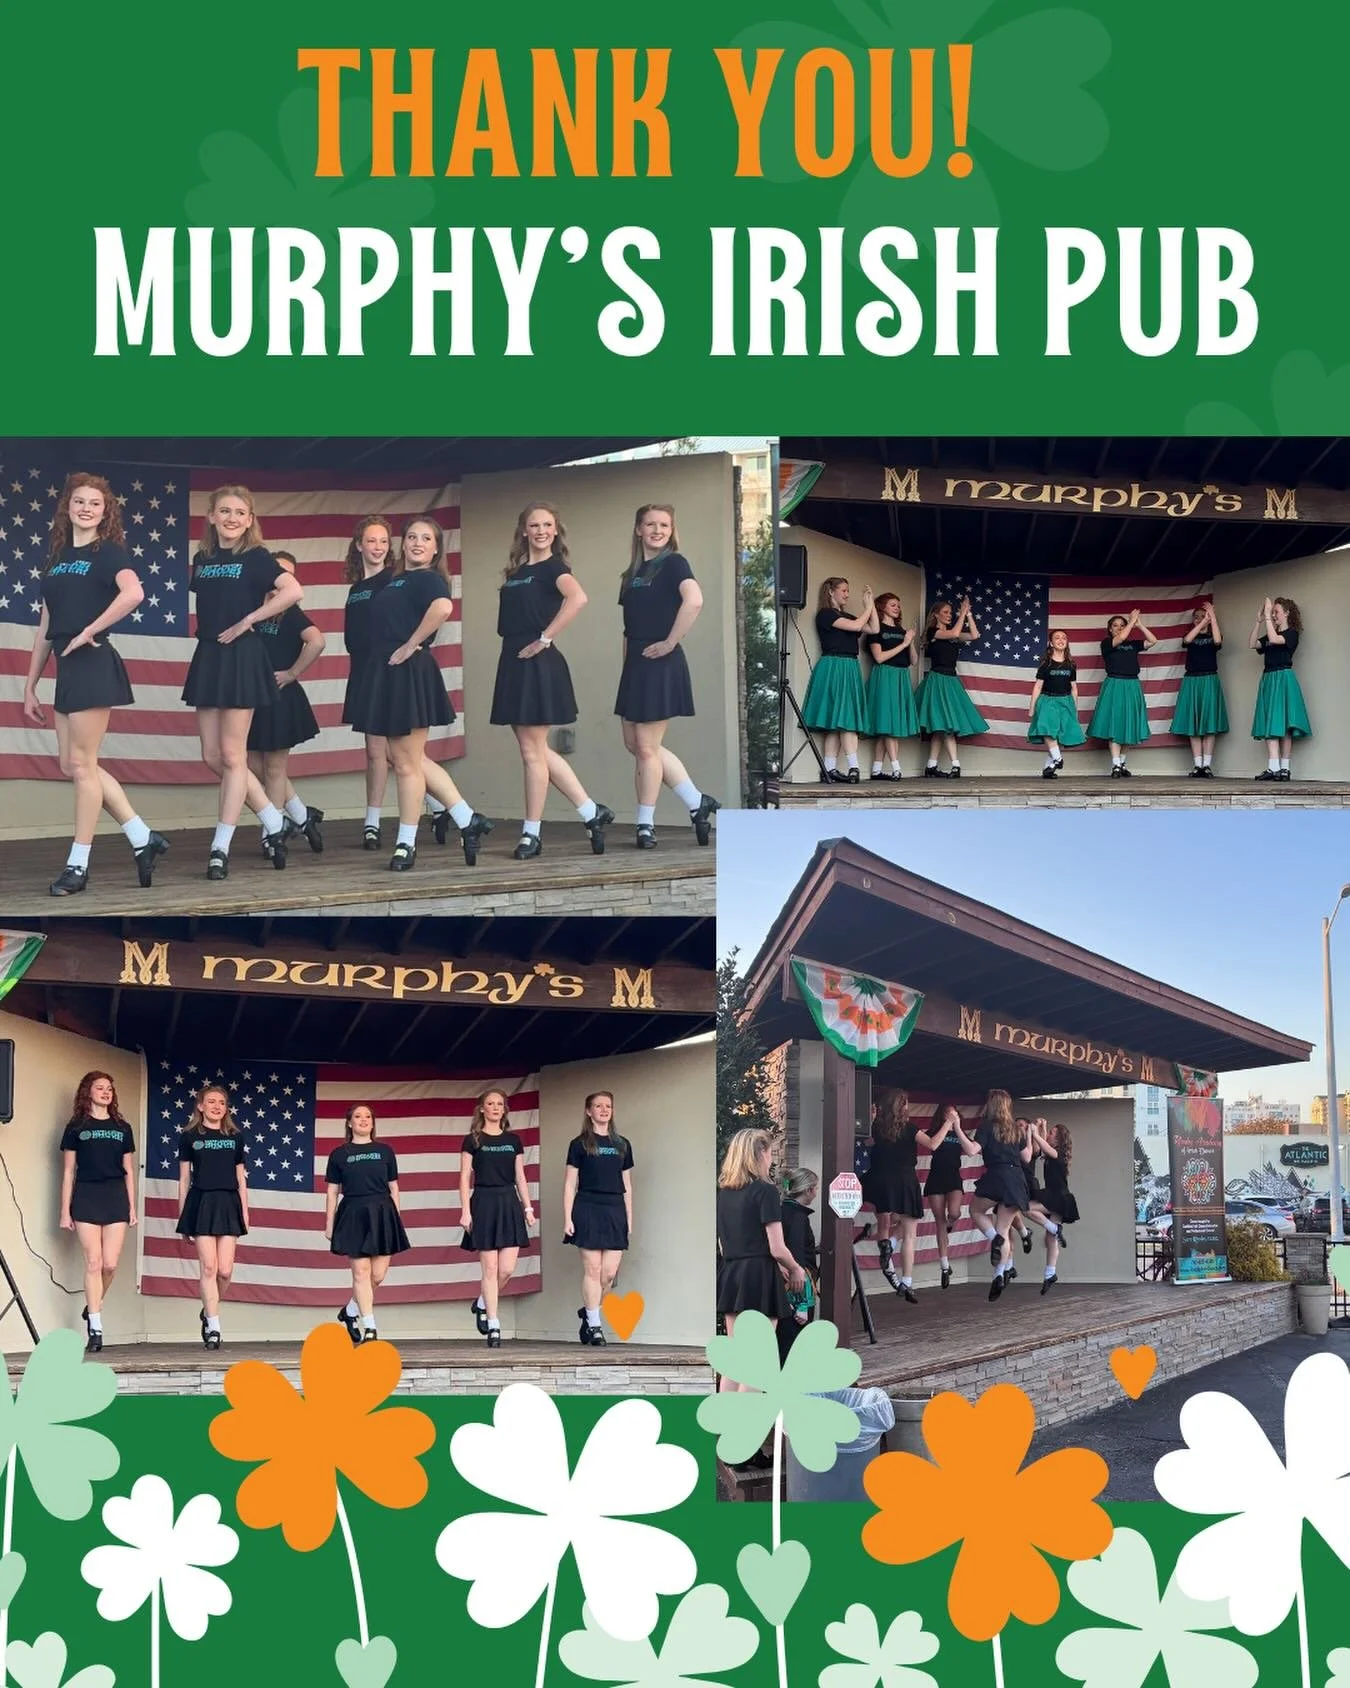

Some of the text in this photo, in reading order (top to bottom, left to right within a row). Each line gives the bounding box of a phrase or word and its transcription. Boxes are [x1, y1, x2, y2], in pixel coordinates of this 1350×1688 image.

[881, 467, 921, 503] M
[1263, 487, 1299, 520] M
[118, 940, 172, 987] M
[610, 967, 657, 1009] M
[957, 1004, 982, 1043] M
[1140, 1056, 1155, 1082] M
[1284, 1151, 1328, 1160] ATLANTIC
